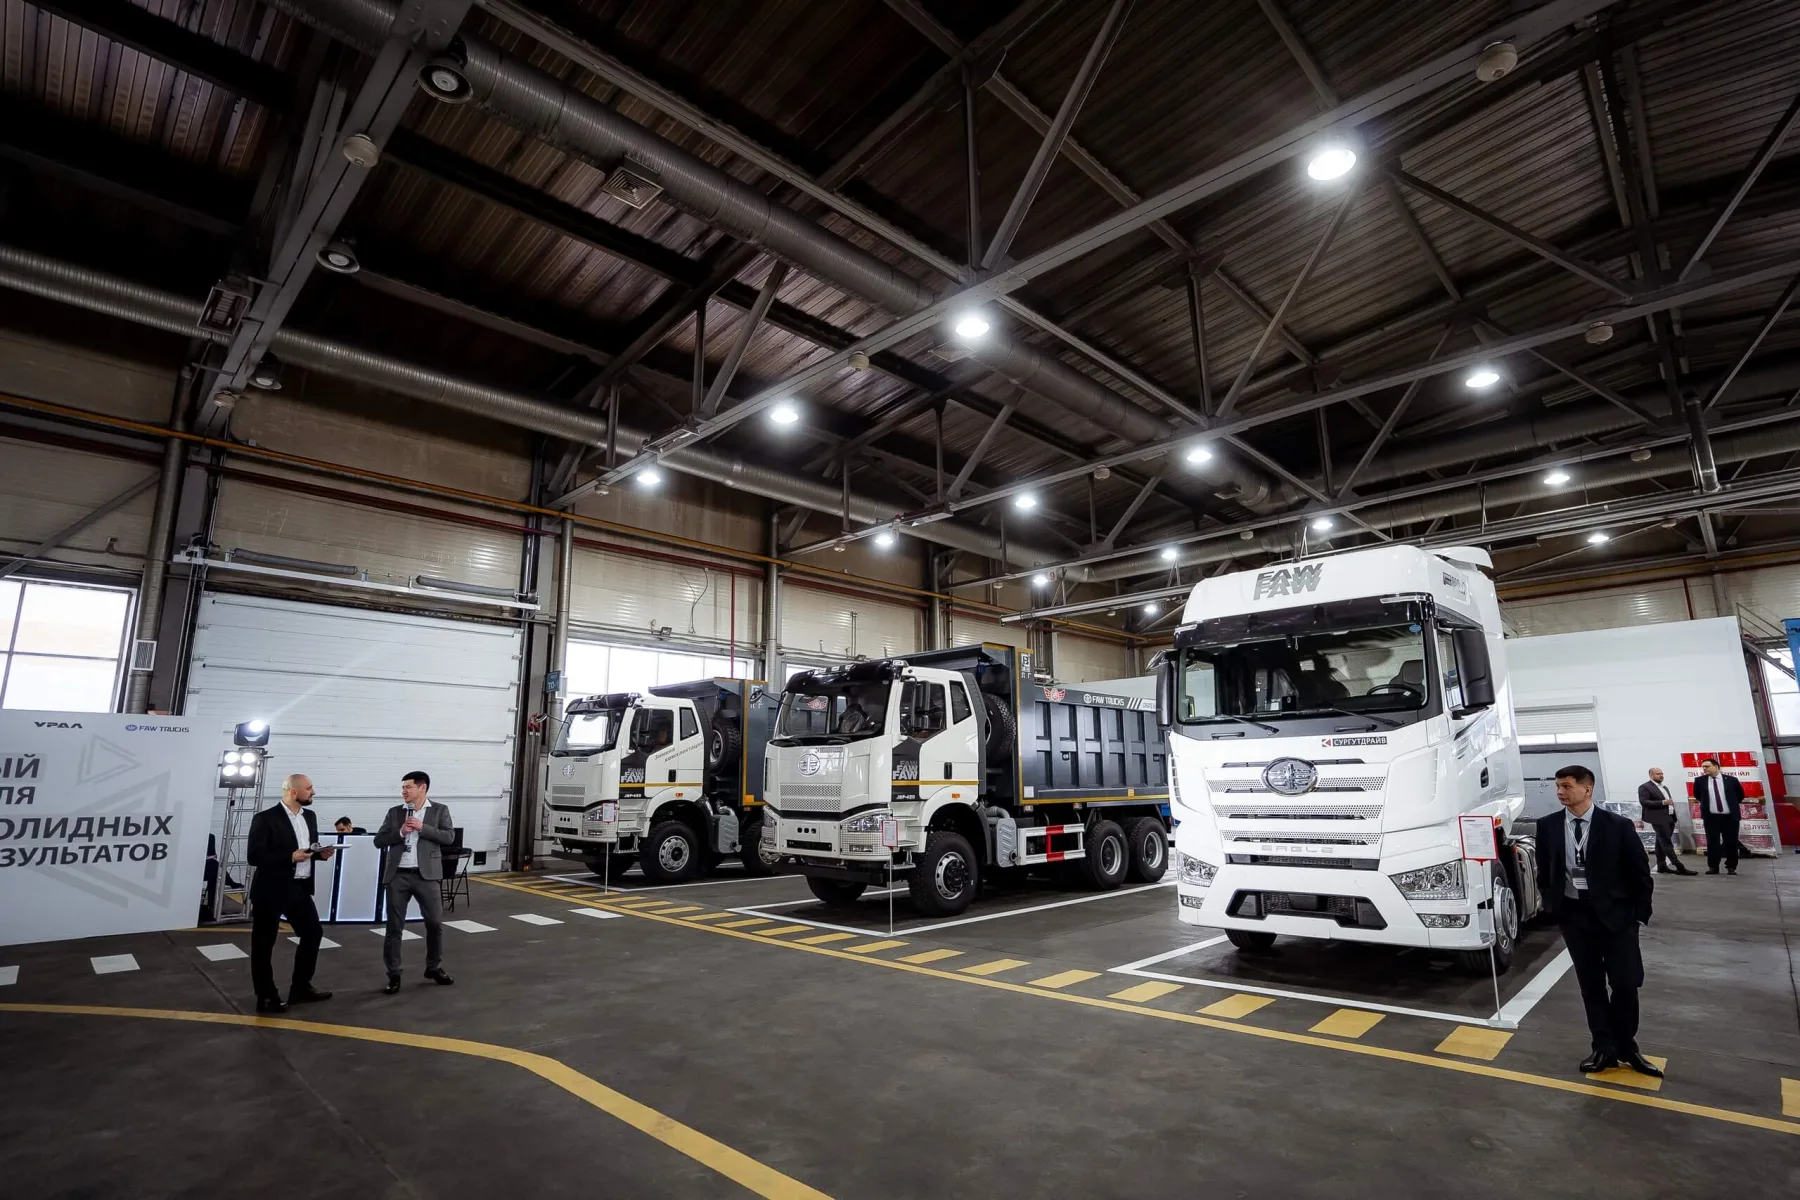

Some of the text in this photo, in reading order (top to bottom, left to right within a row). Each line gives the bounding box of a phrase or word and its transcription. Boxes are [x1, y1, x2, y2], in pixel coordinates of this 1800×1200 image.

[1092, 695, 1104, 704] FAW
[1333, 737, 1387, 745] СУРГУТДРАЙВ
[620, 775, 645, 783] FAW
[892, 770, 918, 780] FAW
